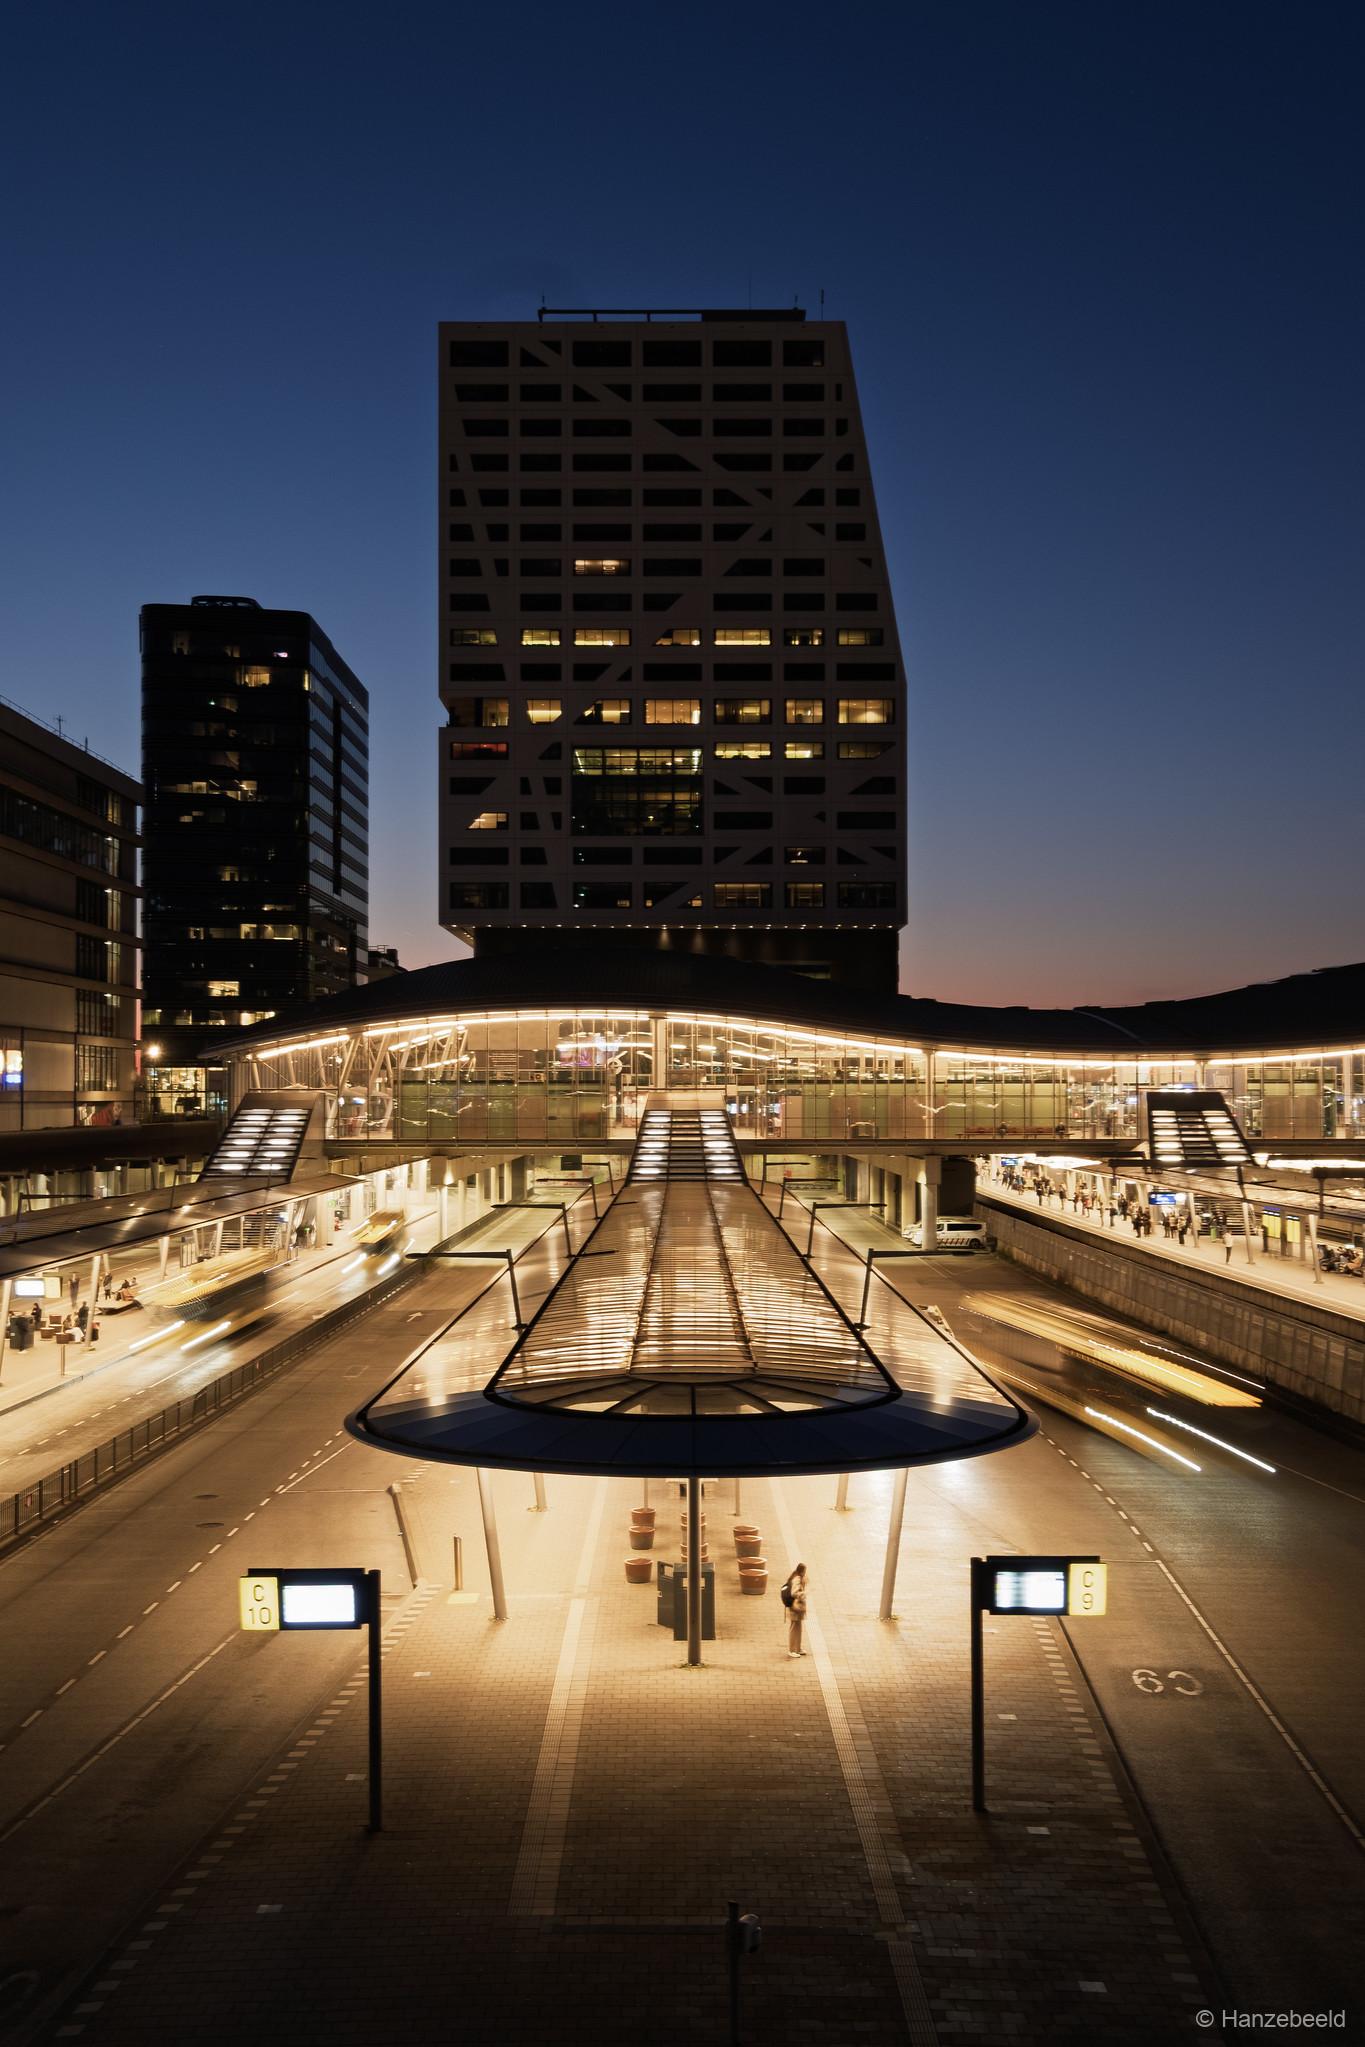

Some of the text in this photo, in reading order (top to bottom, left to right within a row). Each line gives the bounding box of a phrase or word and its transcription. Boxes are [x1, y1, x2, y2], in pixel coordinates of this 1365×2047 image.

[1082, 1570, 1094, 1588] C
[252, 1584, 265, 1602] C
[1082, 1592, 1094, 1610] 9
[248, 1606, 271, 1625] 10
